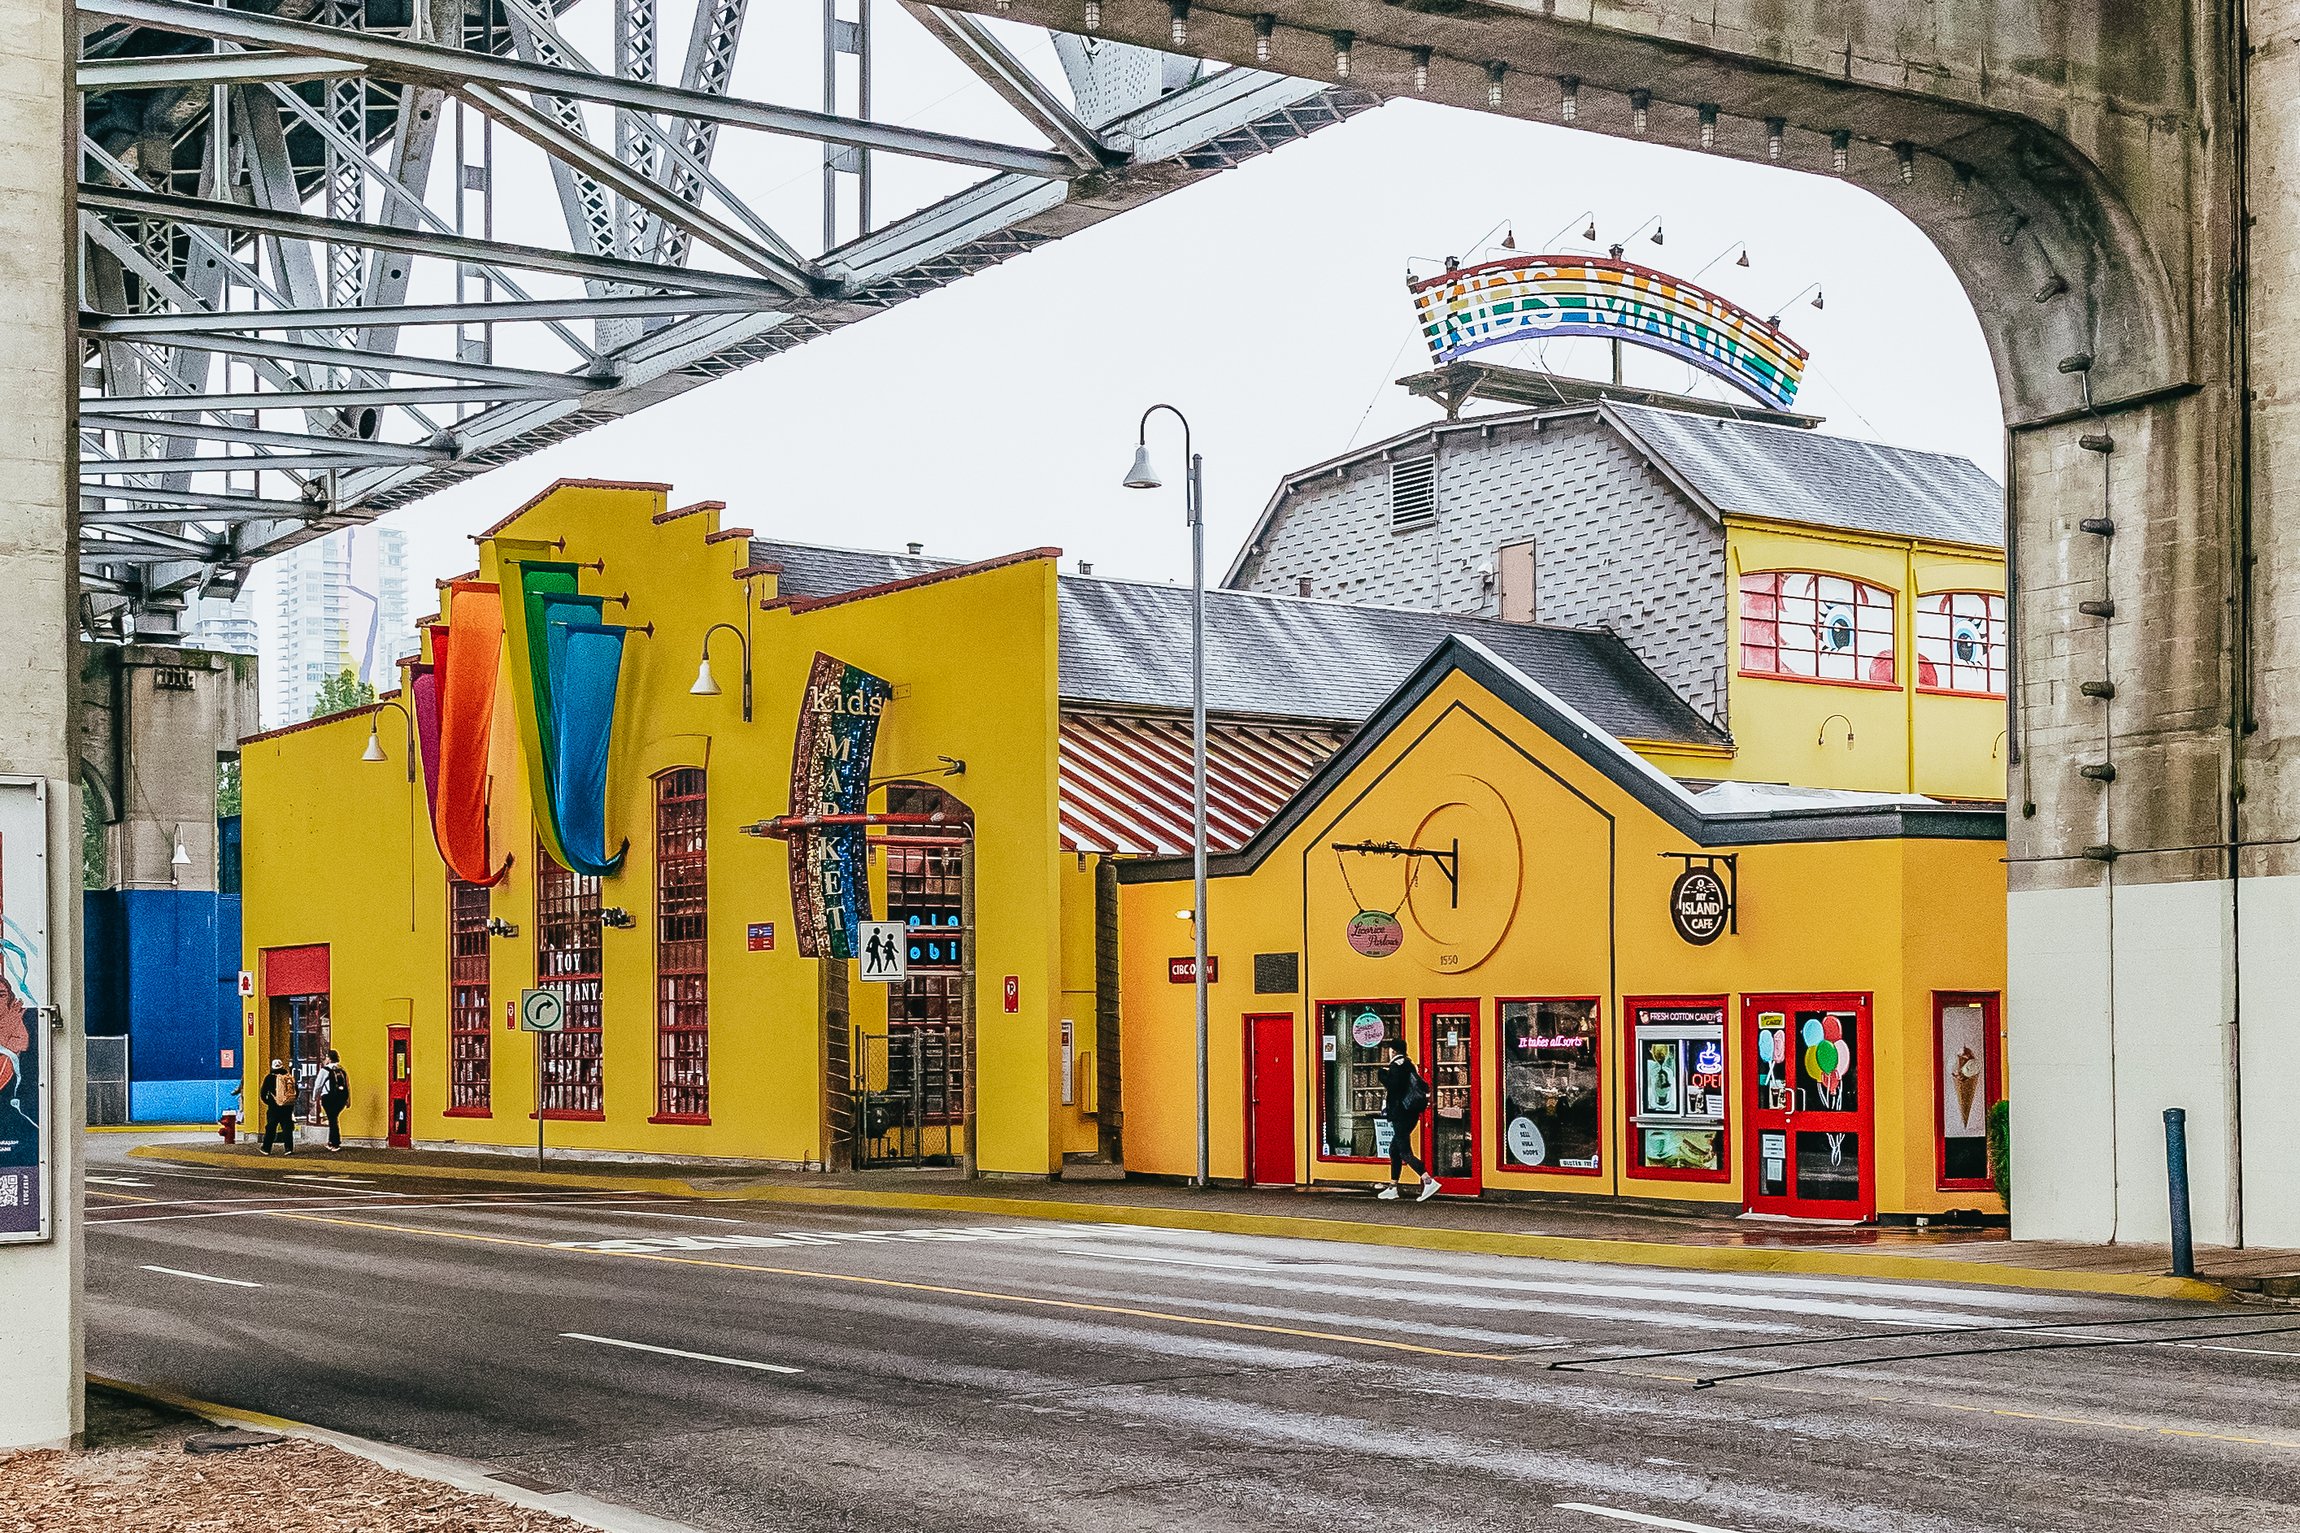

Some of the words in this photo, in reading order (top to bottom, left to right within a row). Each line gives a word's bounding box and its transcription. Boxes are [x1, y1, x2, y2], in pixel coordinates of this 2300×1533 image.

[1424, 261, 1563, 355] KIDS
[1584, 261, 1801, 401] MARKET
[809, 686, 884, 716] kids
[1682, 902, 1719, 915] ISLAND
[1691, 918, 1713, 929] CAFE
[556, 953, 580, 972] TOY
[1440, 954, 1458, 966] 1550
[1172, 964, 1189, 975] CIBC
[1650, 1012, 1669, 1021] FRESH
[1670, 1012, 1693, 1021] COTTON
[1695, 1012, 1716, 1022] CANDY
[1518, 1037, 1527, 1048] It
[1528, 1035, 1549, 1047] takes
[1550, 1034, 1564, 1047] all
[1563, 1036, 1582, 1047] sorts
